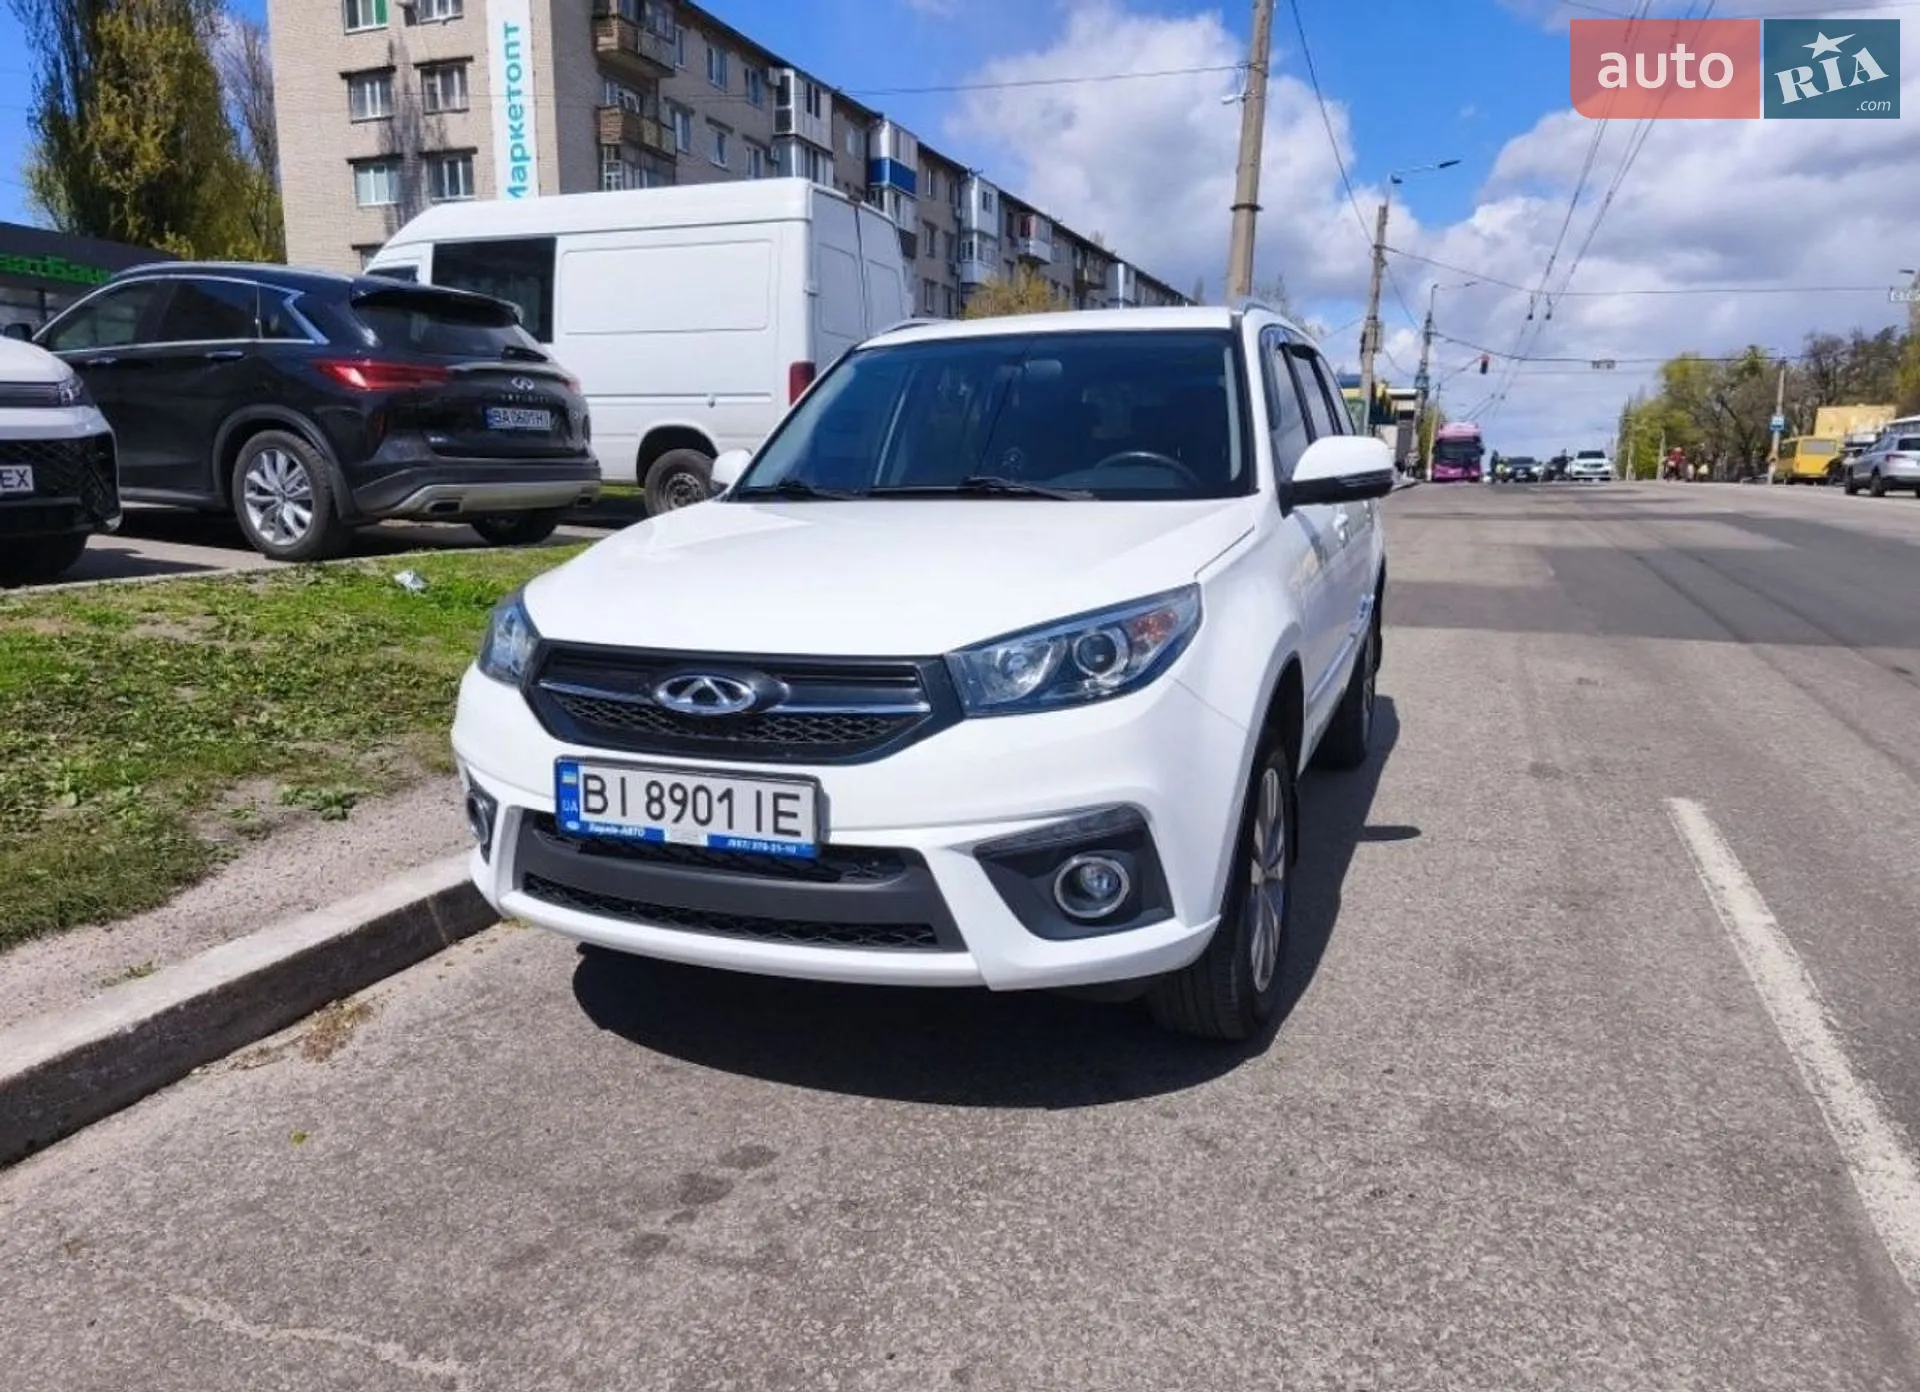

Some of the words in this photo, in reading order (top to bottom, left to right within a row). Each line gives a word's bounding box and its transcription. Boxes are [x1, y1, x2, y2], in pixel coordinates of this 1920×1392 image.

[1, 468, 30, 489] EX
[582, 773, 628, 818] BI
[645, 779, 734, 830] 8901
[755, 789, 802, 838] IE
